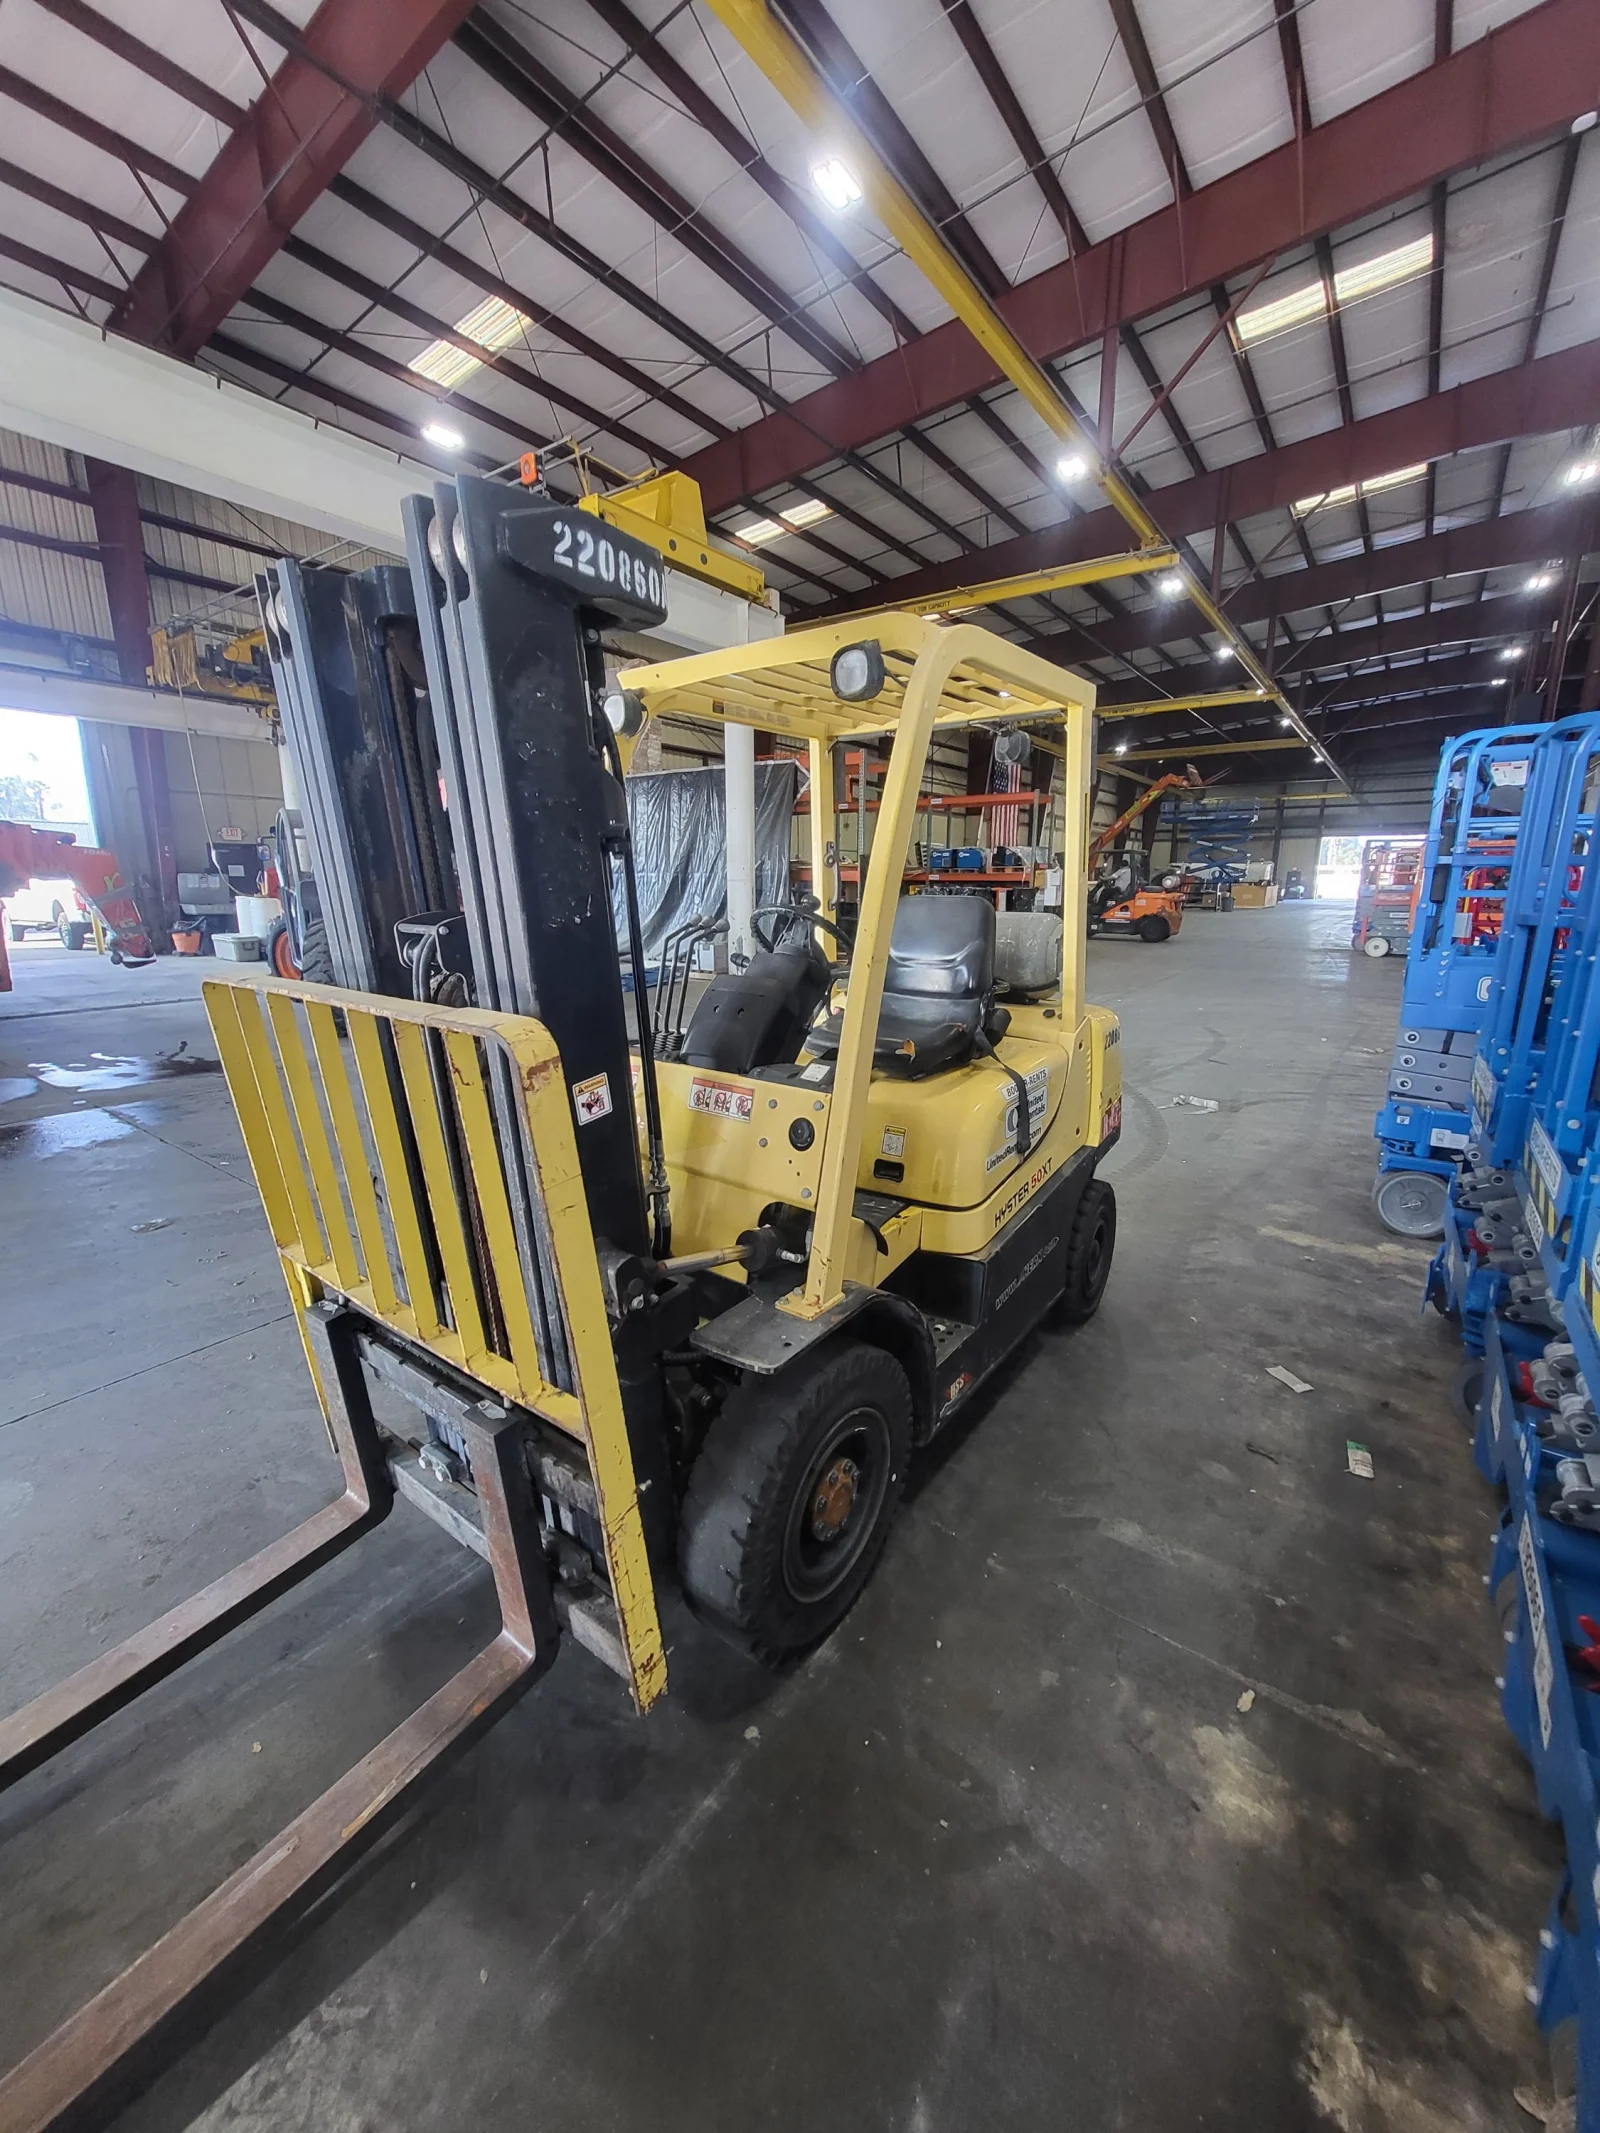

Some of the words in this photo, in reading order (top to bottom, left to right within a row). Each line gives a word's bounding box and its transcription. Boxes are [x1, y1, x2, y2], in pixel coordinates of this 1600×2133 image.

[226, 828, 239, 837] EXIT
[994, 1182, 1030, 1228] HYSTER
[1031, 1157, 1053, 1189] 50XT
